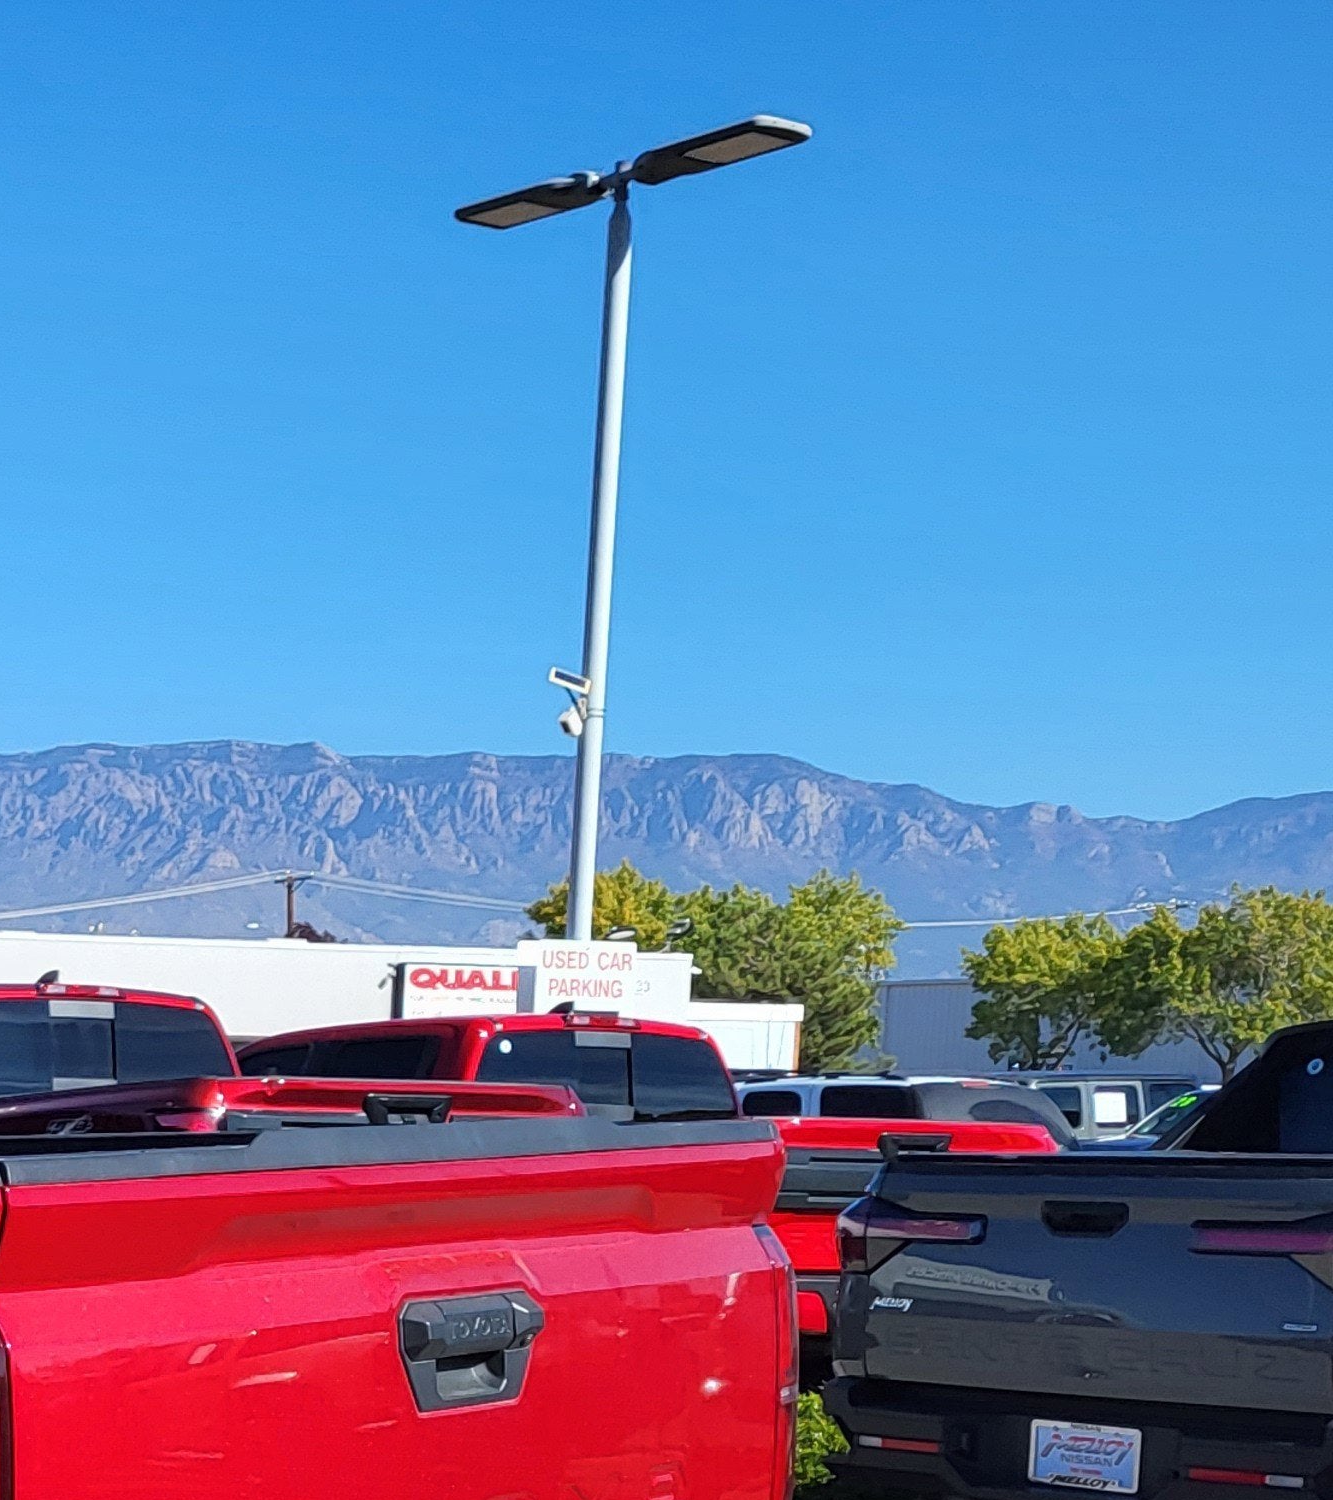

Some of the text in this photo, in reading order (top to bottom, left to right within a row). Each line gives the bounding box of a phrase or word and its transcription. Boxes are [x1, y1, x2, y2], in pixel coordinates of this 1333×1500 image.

[542, 950, 633, 971] USED CAR
[548, 978, 623, 998] PARKING
[450, 1312, 512, 1340] TOYOTA
[1061, 1454, 1113, 1467] NISSAN
